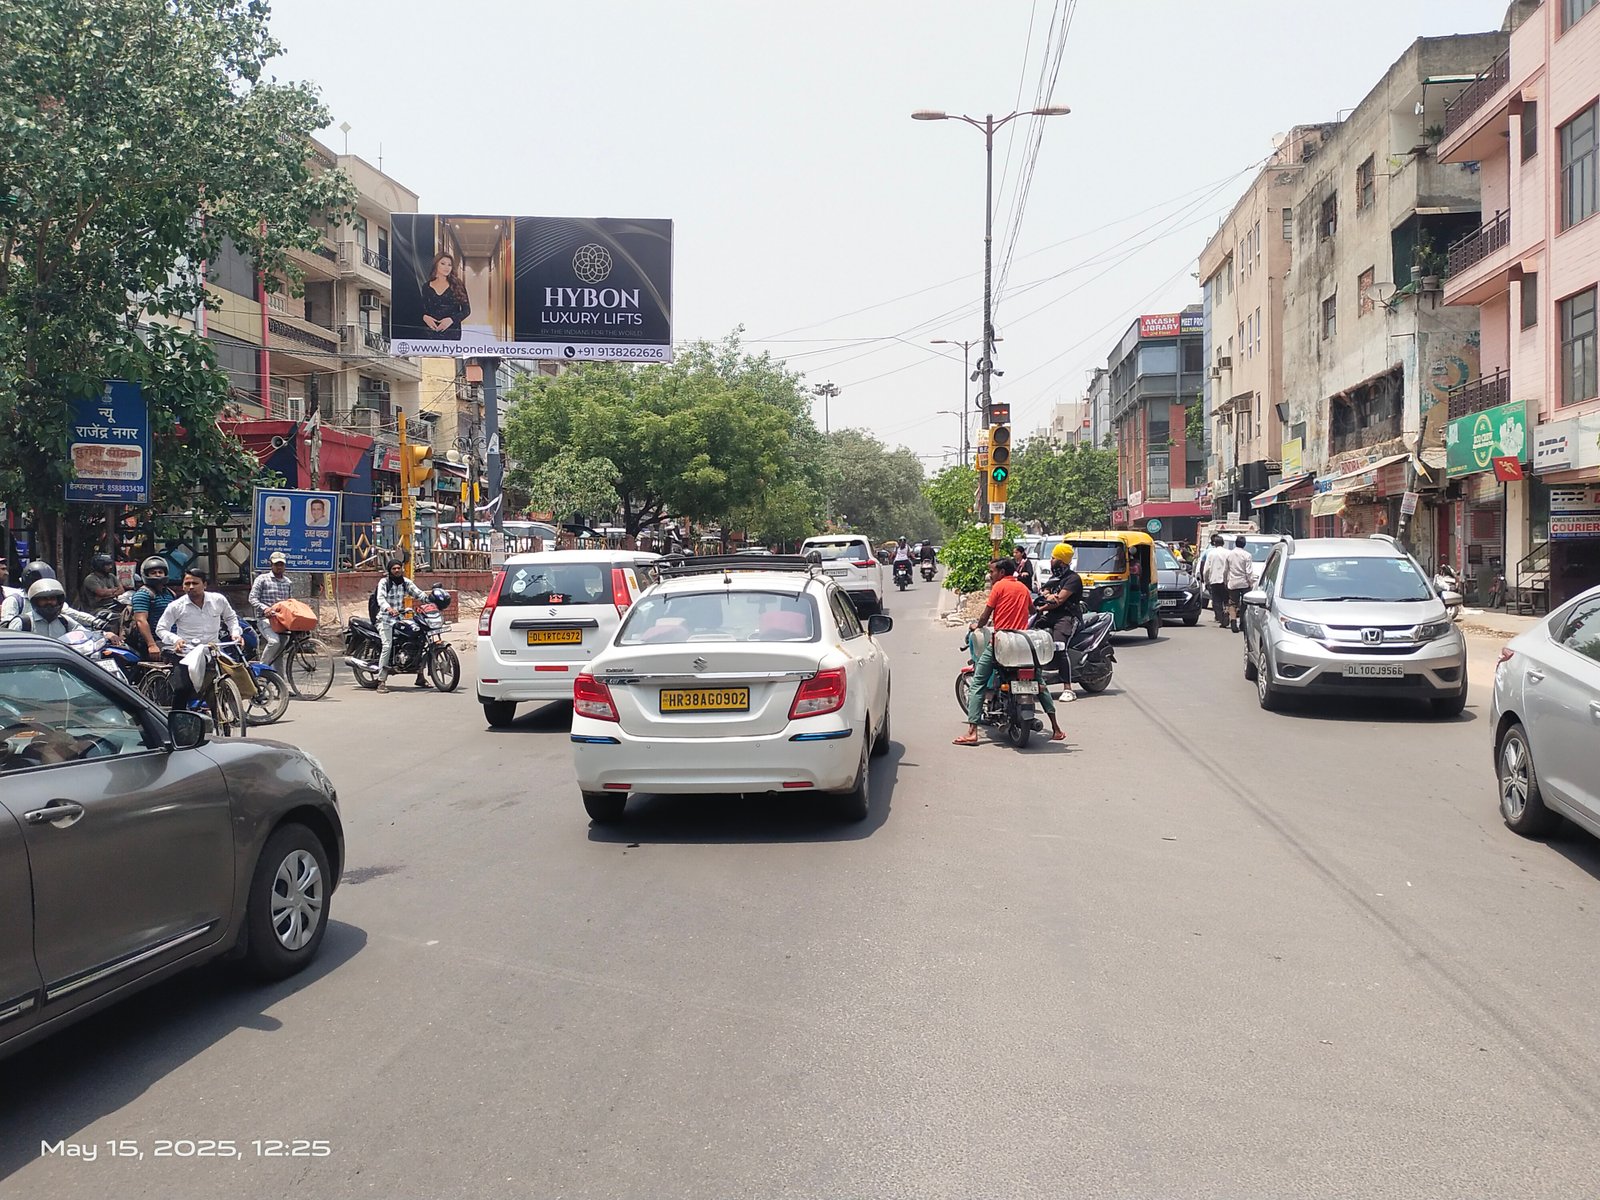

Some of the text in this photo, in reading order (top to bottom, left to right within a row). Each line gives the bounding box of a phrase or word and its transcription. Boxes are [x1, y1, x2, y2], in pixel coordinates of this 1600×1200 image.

[544, 287, 640, 309] HYBON
[541, 311, 643, 325] LUXURY LIFTS
[1145, 317, 1175, 325] AKASH
[1181, 318, 1193, 326] MEET
[410, 343, 553, 355] www.hybonelevators.com
[577, 347, 663, 357] +91 9138262626
[98, 408, 116, 423] न्यू
[75, 422, 139, 439] राजेंद्र नगर
[1538, 436, 1566, 456] DTDC
[1552, 492, 1585, 501] DTDC
[1552, 523, 1600, 532] COURIER
[532, 630, 580, 641] DL1RTC4972
[668, 692, 747, 708] HR38AG0902
